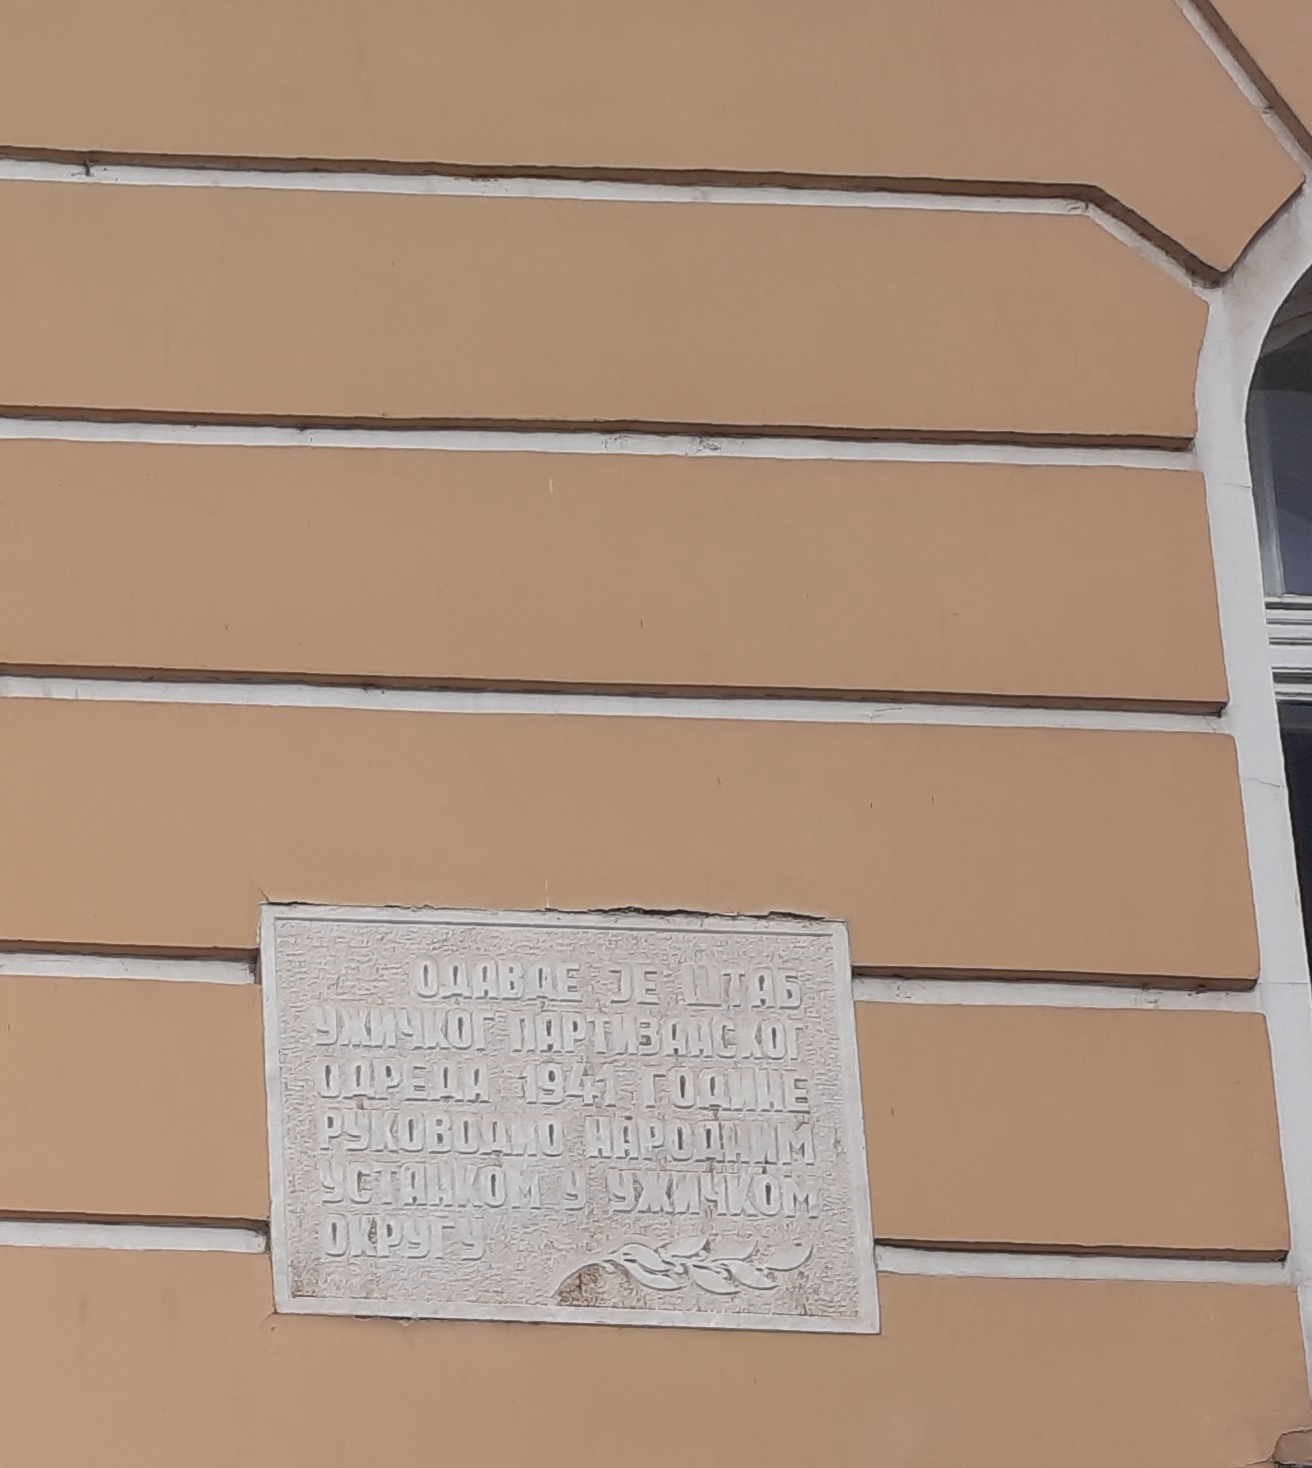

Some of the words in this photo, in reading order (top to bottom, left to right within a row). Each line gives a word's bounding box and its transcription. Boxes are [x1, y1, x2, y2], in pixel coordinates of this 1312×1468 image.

[608, 962, 661, 1006] ЈЕ
[313, 1006, 495, 1051] УЖИЧКОГ
[316, 1059, 491, 1103] ОДРЕДА
[524, 1063, 617, 1108] 1941
[642, 1066, 811, 1115] ГОДИНЕ
[584, 1116, 816, 1167] НАРОДНИМ
[320, 1160, 542, 1210] УСТАНКОМ
[607, 1170, 819, 1220] УЖИЧКОМ
[321, 1213, 486, 1261] ОКРУГУ
